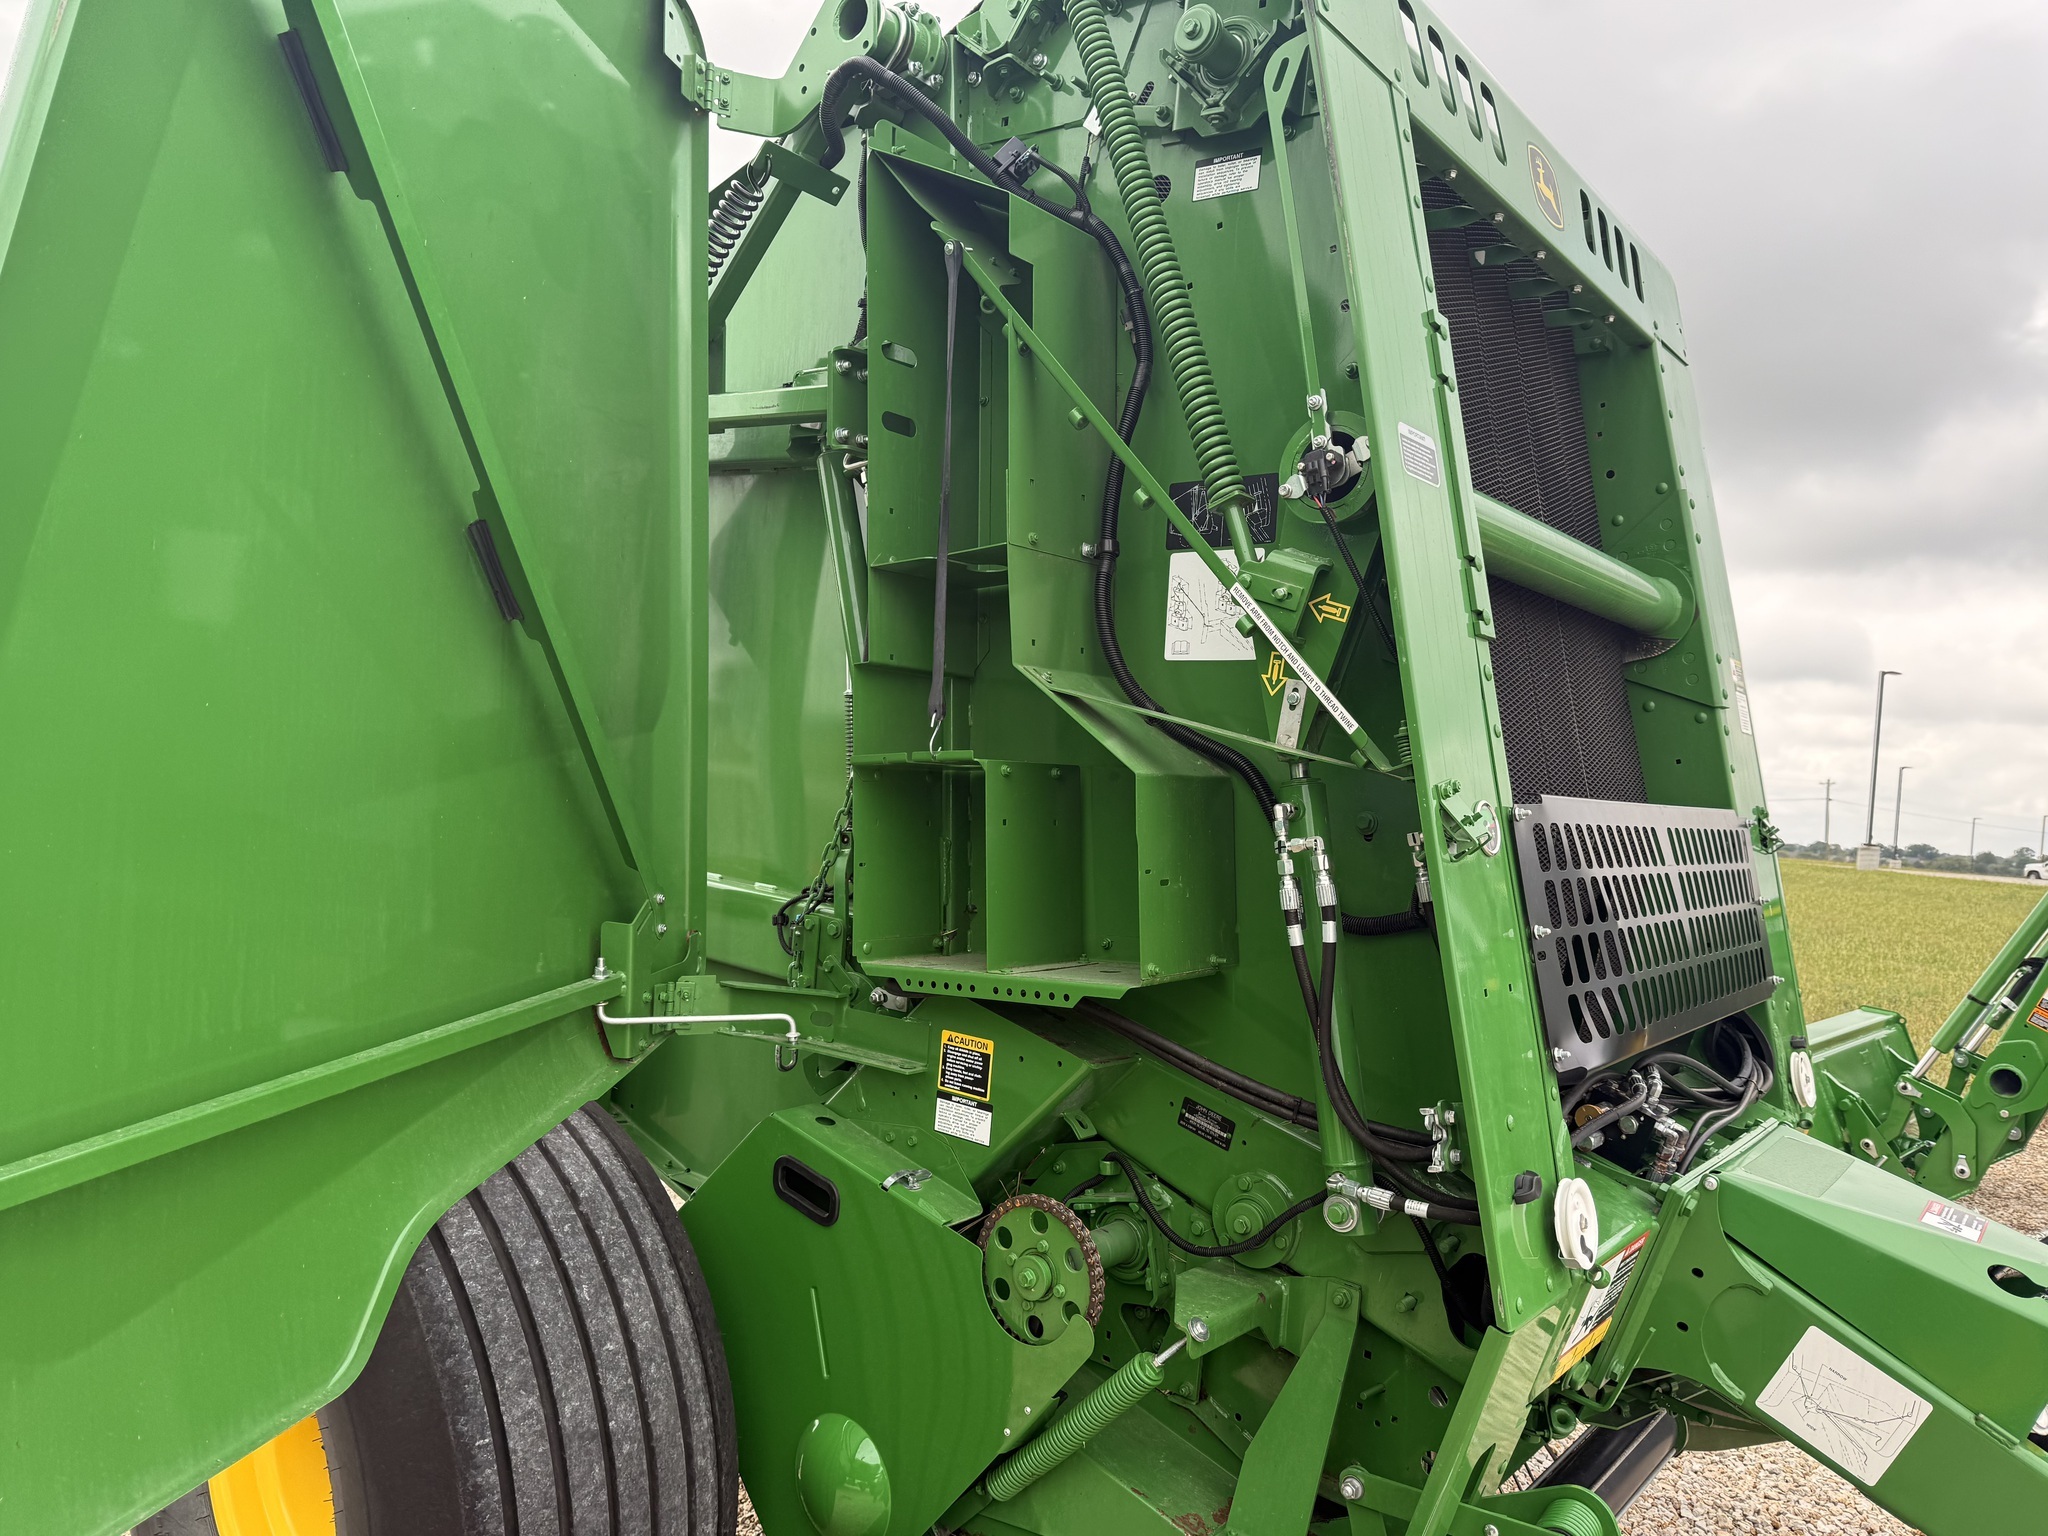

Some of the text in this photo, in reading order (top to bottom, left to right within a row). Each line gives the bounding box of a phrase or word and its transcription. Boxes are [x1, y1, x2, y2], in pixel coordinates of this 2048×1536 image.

[1213, 153, 1244, 163] IMPORTANT
[1232, 586, 1355, 730] REMOVE ARM FROM NOTCH AND LOWER TO THREAD TWINE
[953, 1036, 989, 1051] CAUTION
[951, 1096, 977, 1107] IMPORTANT
[1829, 1366, 1848, 1381] NARROW
